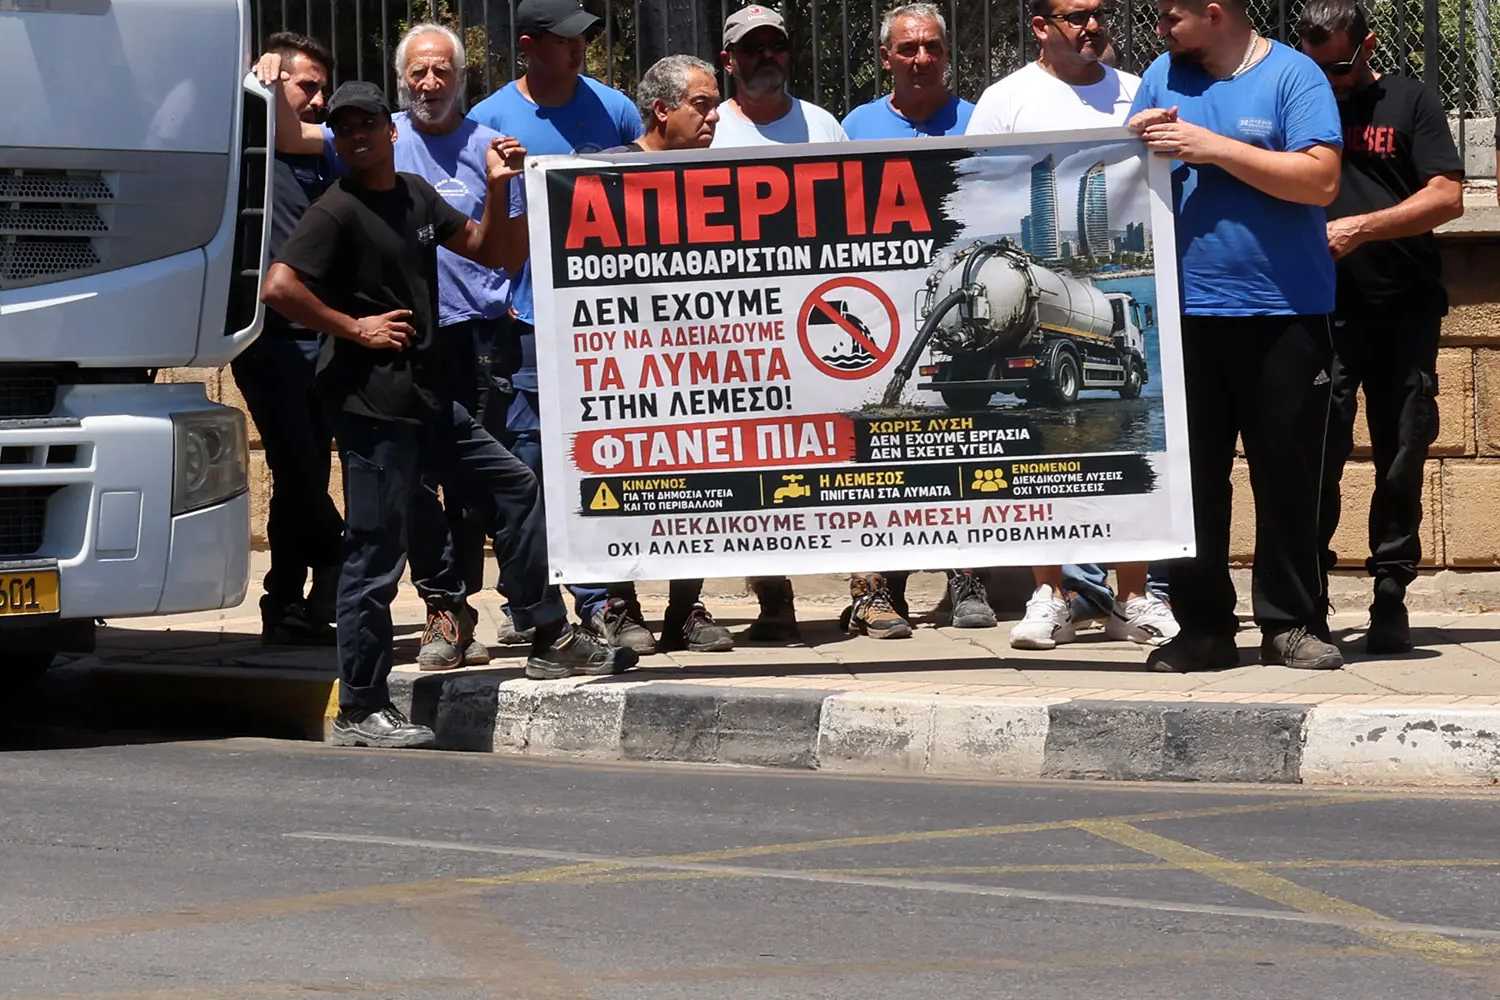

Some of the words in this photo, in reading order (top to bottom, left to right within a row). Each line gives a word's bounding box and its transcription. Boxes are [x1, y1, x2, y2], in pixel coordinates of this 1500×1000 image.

[565, 158, 932, 249] ΑΠΕΡΓΙΑ
[567, 242, 811, 281] ΒΟΘΡΟΚΑΘΑΡΙΣΤΩΝ
[819, 239, 935, 268] ΛΕΜΕΣΟΥ
[572, 296, 639, 327] ΔΕΝ
[651, 287, 783, 322] ΕΧΟΥΜΕ
[573, 331, 617, 353] ΠΟΥ
[624, 329, 653, 349] ΝΑ
[660, 320, 785, 347] ΑΔΕΙΑΖΟΥΜΕ
[575, 356, 625, 392] ΤΑ
[638, 347, 792, 388] ΛΥΜΑΤΑ
[580, 393, 658, 422] ΣΤΗΝ
[669, 385, 793, 416] ΛΕΜΕΣΟ!
[868, 420, 922, 434] ΧΩΡΙΣ
[928, 417, 973, 431] ΛΥΣΗ
[591, 426, 743, 469] ΦΤΑΝΕΙ
[755, 421, 837, 461] ΠΙΑ!
[870, 434, 900, 447] ΔΕΝ
[905, 431, 965, 445] ΕΧΟΥΜΕ
[969, 428, 1031, 442] ΕΡΓΑΣΙΑ
[870, 448, 901, 460] ΔΕΝ
[906, 445, 955, 458] ΕΧΕΤΕ
[959, 442, 1004, 456] ΥΓΕΙΑ
[1011, 461, 1081, 474] ΕΝΩΜΕΝΟΙ
[622, 478, 687, 491] ΚΙΝΔΥΝΟΣ
[820, 474, 830, 488] Η
[834, 471, 905, 487] ΛΕΜΕΣΟΣ
[1012, 473, 1083, 485] ΔΙΕΚΔΙΚΟΥΜΕ
[1086, 471, 1123, 482] ΛΥΣΕΙΣ
[623, 492, 639, 502] ΓΙΑ
[641, 491, 655, 501] ΤΗ
[657, 490, 702, 500] ΔΗΜΟΣΙΑ
[704, 489, 733, 498] ΥΓΕΙΑ
[820, 488, 874, 501] ΠΝΙΓΕΤΑΙ
[878, 487, 900, 499] ΣΤΑ
[904, 485, 952, 498] ΛΥΜΑΤΑ
[1013, 486, 1032, 496] ΟΧΙ
[1035, 483, 1105, 495] ΥΠΟΣΧΕΣΕΙΣ
[623, 502, 640, 511] ΚΑΙ
[643, 501, 656, 510] ΤΟ
[659, 499, 723, 510] ΠΕΡΙΒΑΛΛΟΝ
[651, 513, 807, 537] ΔΙΕΚΔΙΚΟΥΜΕ
[814, 511, 878, 530] ΤΩΡΑ
[888, 507, 971, 528] ΑΜΕΣΗ
[982, 503, 1053, 525] ΛΥΣΗ!
[607, 541, 640, 557] ΟΧΙ
[649, 539, 715, 555] ΑΛΛΕΣ
[723, 534, 832, 553] ΑΝΑΒΟΛΕΣ
[860, 532, 894, 548] ΟΧΙ
[902, 529, 958, 546] ΑΛΛΑ
[967, 523, 1112, 544] ΠΡΟΒΛΗΜΑΤΑ!
